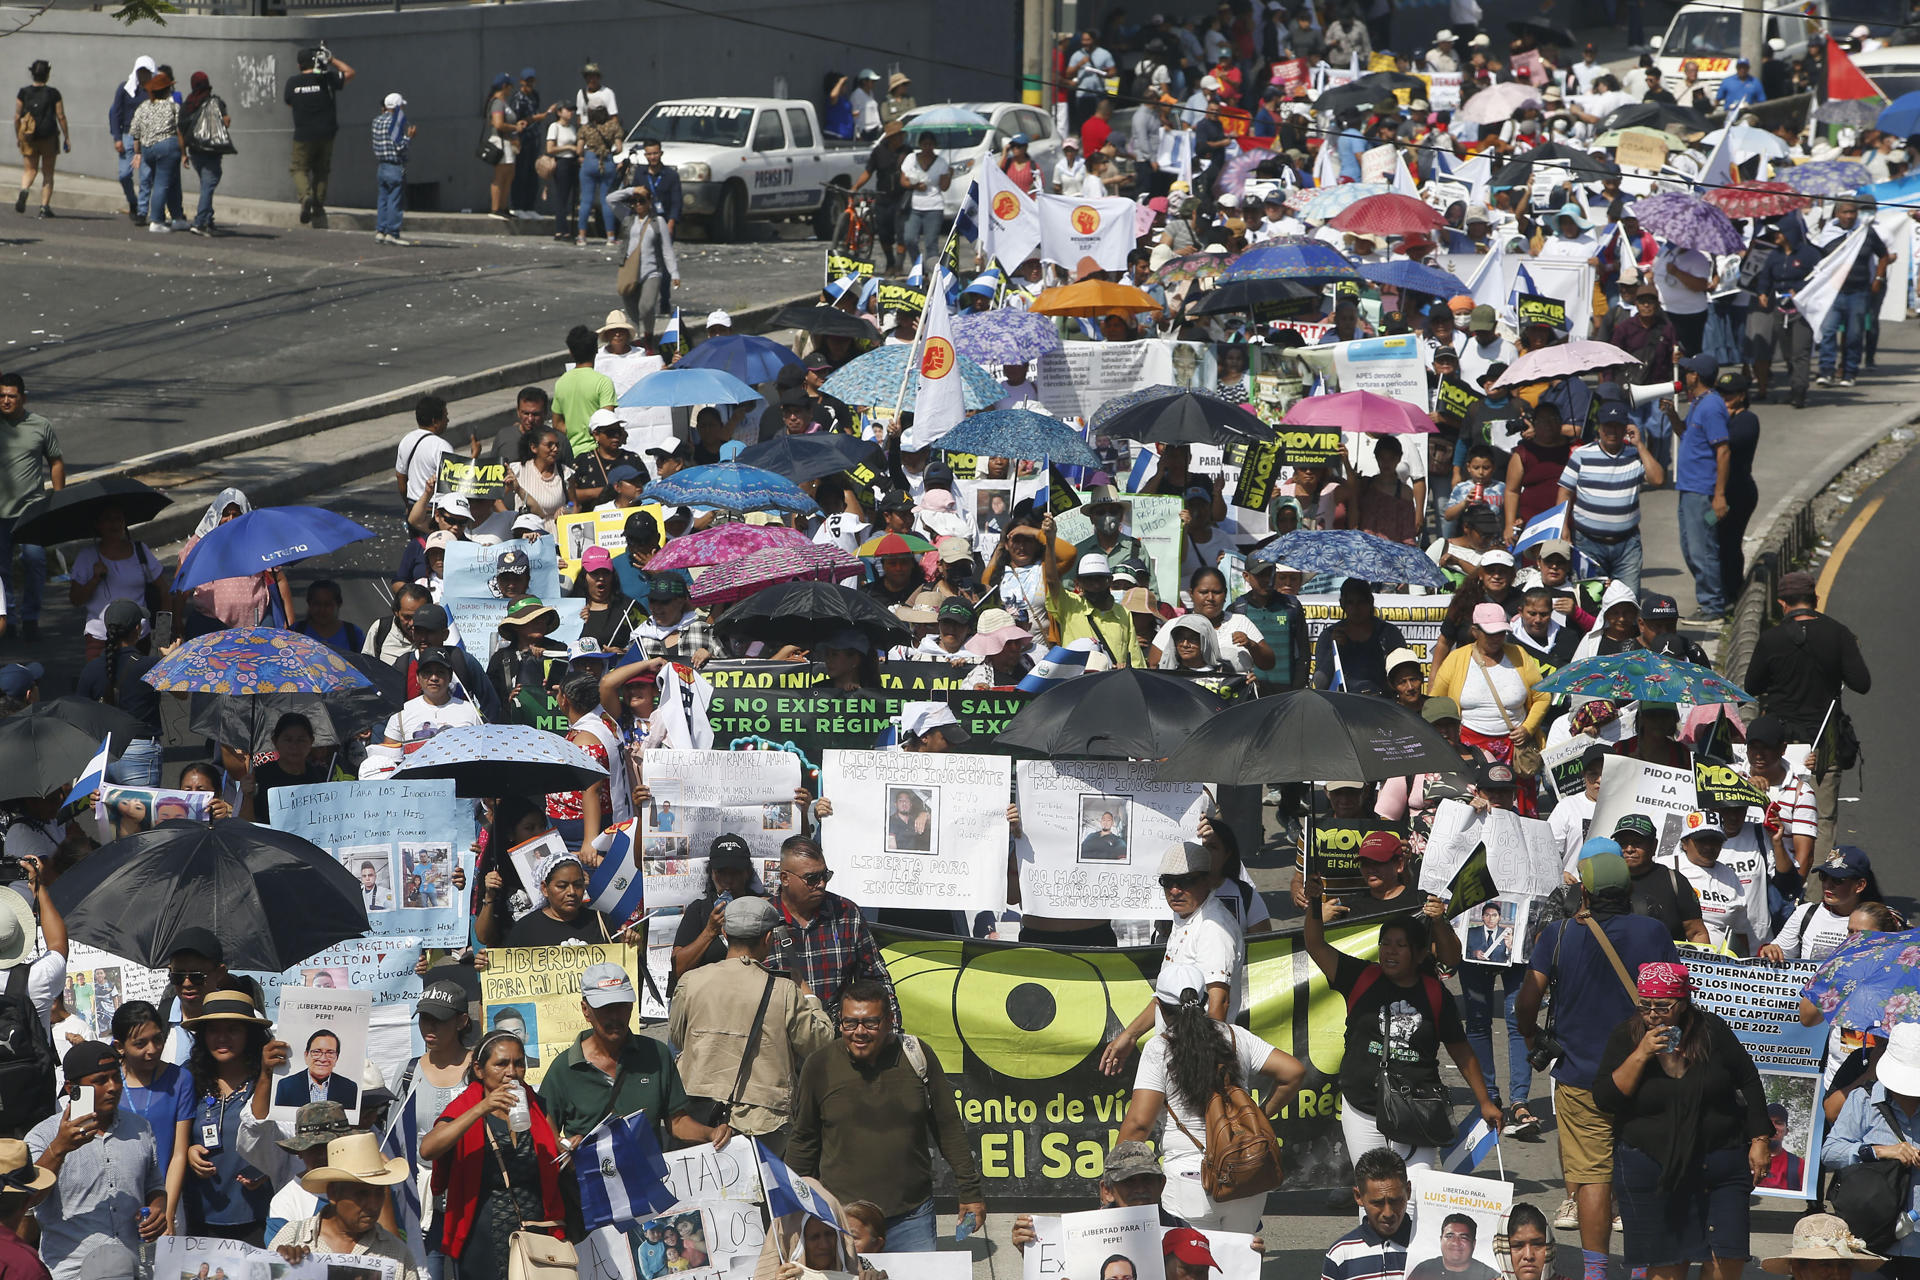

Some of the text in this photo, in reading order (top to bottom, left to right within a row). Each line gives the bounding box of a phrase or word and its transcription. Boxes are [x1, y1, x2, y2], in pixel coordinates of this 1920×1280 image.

[656, 105, 742, 120] PRENSA TV
[755, 167, 794, 189] PRENSA TV
[828, 256, 874, 273] MOVIR
[879, 286, 927, 306] MOVIR
[1520, 301, 1566, 320] MOVIR
[1275, 431, 1340, 450] MOVIR
[1200, 456, 1221, 466] PARA
[1295, 455, 1326, 463] Salvador
[440, 459, 505, 482] MOVIR
[1140, 518, 1167, 535] HIJO
[1382, 607, 1426, 622] PARA MI
[735, 697, 768, 713] NO
[777, 698, 876, 714] EXISTEN
[711, 713, 807, 733] STRÓ EL
[727, 753, 761, 767] RAMIREZ
[765, 753, 791, 766] AMAYA
[839, 750, 987, 771] LIBERTAD PARA
[842, 765, 1005, 786] MI HIJO INOCENTE
[1027, 760, 1159, 780] LIBERTAD PAR
[1559, 764, 1566, 780] 2
[1644, 767, 1673, 780] PIDO
[350, 784, 448, 799] PARA LOS INOCENTES
[1033, 778, 1203, 795] MI HIJO INOCENTE...
[1661, 784, 1677, 795] LA
[1636, 795, 1696, 812] LIBERACION
[1714, 791, 1764, 806] El Salvador
[307, 807, 356, 826] LIBERTAD
[363, 811, 381, 820] PARA
[403, 810, 425, 820] HIJO
[850, 854, 970, 875] LIBERTA PARA
[1327, 859, 1336, 868] El
[1725, 859, 1756, 873] BRP
[891, 869, 921, 884] LOS
[1028, 869, 1048, 883] NO
[1053, 866, 1088, 885] MÁS
[862, 879, 972, 897] INOCENTES...
[1032, 883, 1152, 900] SEPARADAS POR
[1702, 889, 1730, 904] BRP
[1050, 895, 1164, 910] INJUSTICIA...
[356, 939, 413, 952] REGIMEN
[487, 946, 607, 976] LIBERDAD
[1735, 958, 1792, 971] LIBERTAD
[269, 977, 301, 988] Ernesto
[351, 965, 415, 985] Capturado
[1716, 966, 1789, 984] HERNÁNDEZ
[486, 975, 527, 1000] PARA
[528, 973, 551, 996] MI
[1705, 979, 1798, 997] LOS INOCENTES
[1735, 996, 1748, 1005] EL
[315, 1013, 334, 1021] PEPE!
[1714, 1006, 1800, 1023] FUE CAPTURAD
[1751, 1022, 1783, 1034] 2022.
[1758, 1044, 1812, 1056] QUE PAGUEN
[1759, 1054, 1771, 1064] LOS
[1045, 1091, 1085, 1124] de
[980, 1129, 1026, 1179] El
[1443, 1186, 1486, 1199] LIBERTAD PARA
[1424, 1192, 1503, 1212] LUIS MENJIVAR
[707, 1207, 766, 1254] LOS
[1082, 1223, 1141, 1238] ¡LIBERTAD PARA
[1103, 1236, 1124, 1246] PEPE!
[167, 1236, 175, 1253] 9
[185, 1237, 207, 1252] DE
[316, 1253, 334, 1265] YA
[338, 1254, 362, 1267] SON
[368, 1257, 382, 1269] 28
